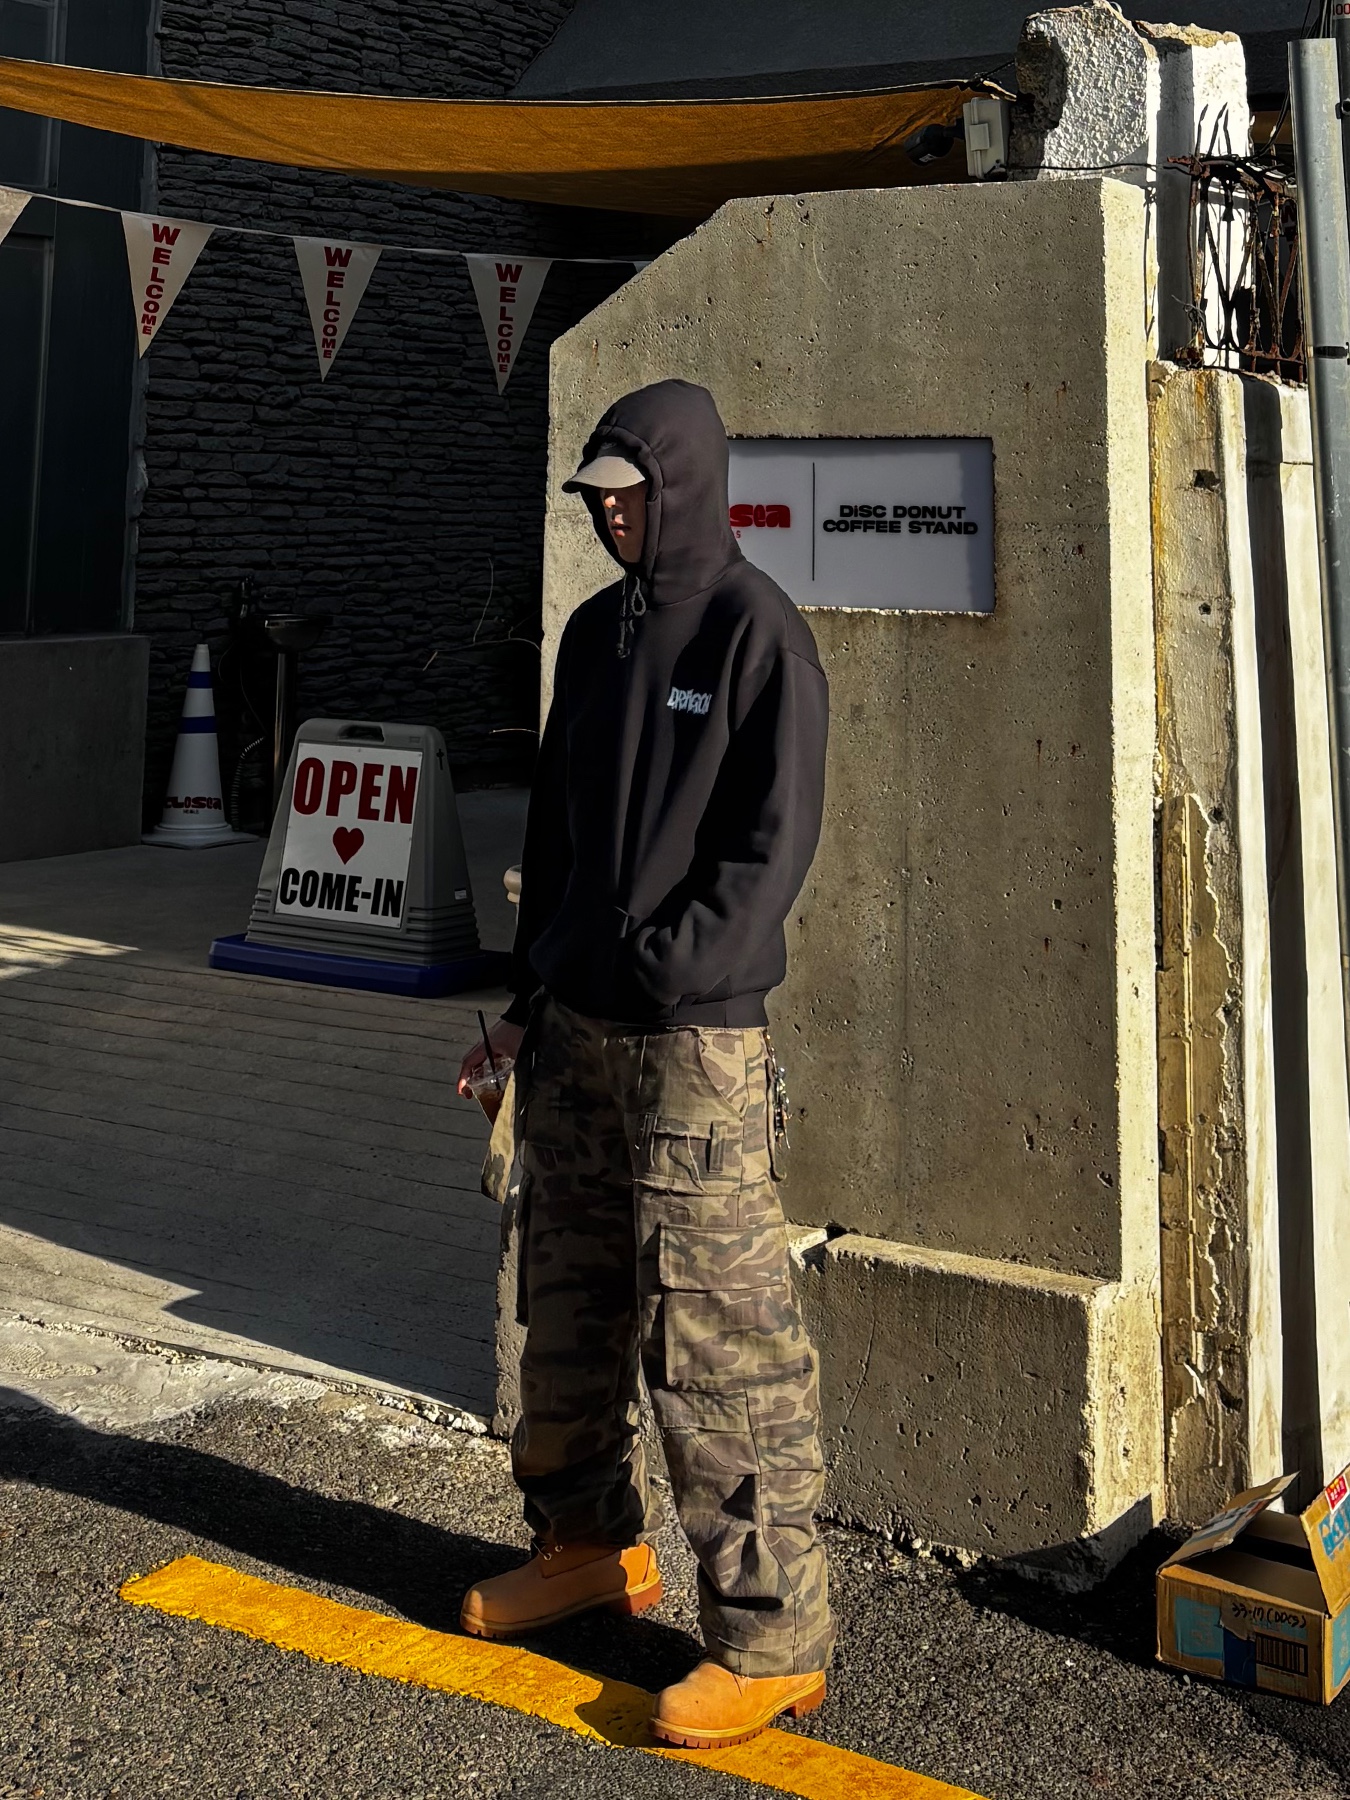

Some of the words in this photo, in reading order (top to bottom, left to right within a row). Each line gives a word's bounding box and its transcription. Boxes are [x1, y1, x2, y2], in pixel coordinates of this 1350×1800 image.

[141, 223, 181, 335] WELCOME
[322, 246, 353, 359] WELCOME
[495, 262, 523, 373] WELCOME
[729, 503, 791, 528] sea
[822, 519, 902, 533] COFFEE
[908, 520, 979, 535] STAND
[892, 505, 967, 519] DONUT
[293, 757, 418, 824] OPEN
[279, 867, 404, 918] COME-IN
